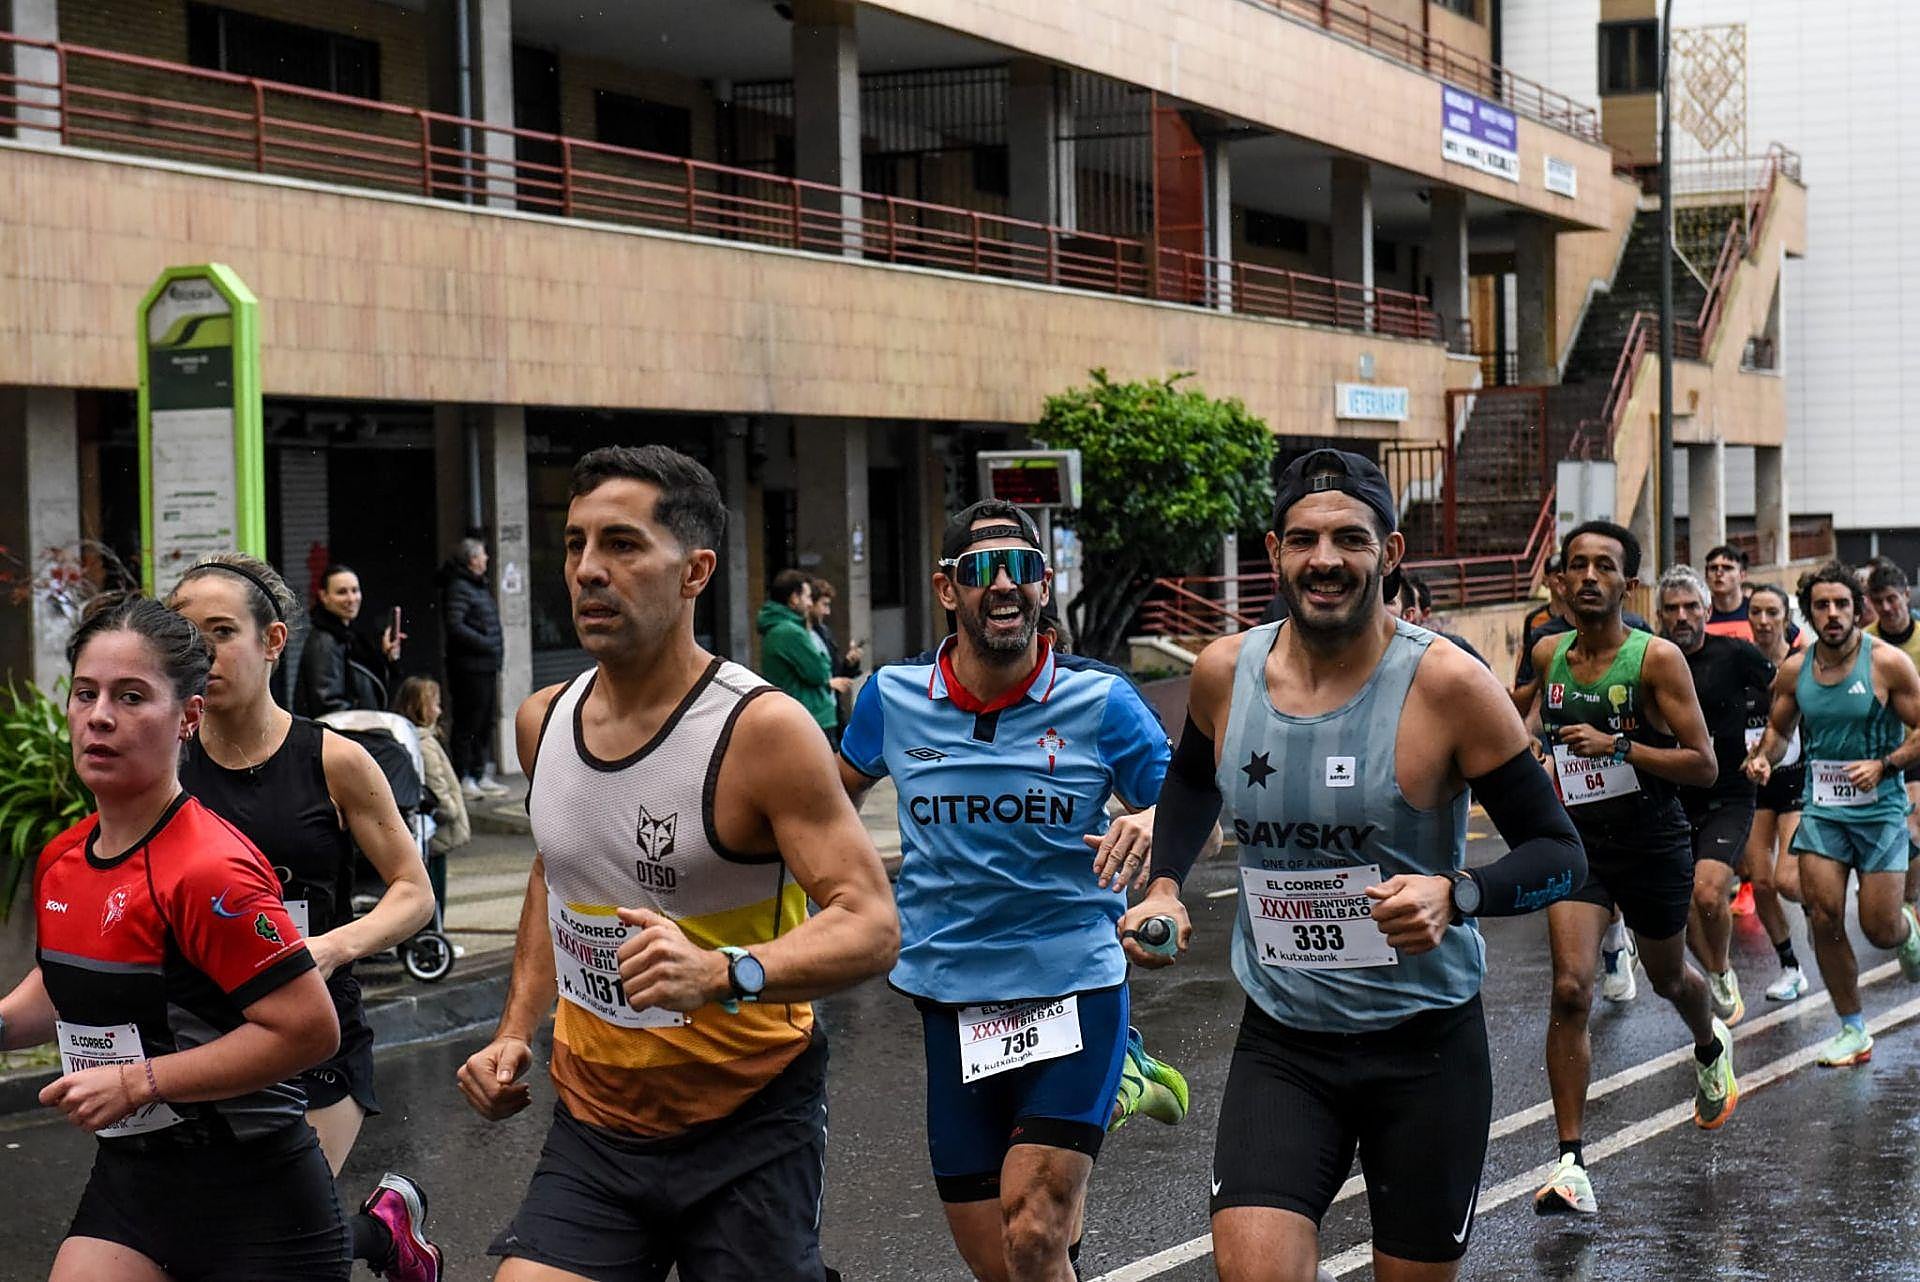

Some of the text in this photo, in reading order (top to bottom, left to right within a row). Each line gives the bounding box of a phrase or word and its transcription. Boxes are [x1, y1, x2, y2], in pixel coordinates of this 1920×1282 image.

[1585, 772, 1605, 790] 64
[910, 788, 1074, 825] CITROËN
[1233, 818, 1376, 850] SAYSKY
[637, 861, 676, 887] OTSO
[1288, 859, 1304, 871] OF
[1266, 880, 1344, 890] EL CORREO
[1259, 897, 1312, 920] XXXVII
[1312, 896, 1370, 909] SANTURCE
[1313, 906, 1371, 919] BILBAO
[569, 918, 628, 938] CORREO
[1293, 924, 1344, 951] 333
[1280, 951, 1339, 961] kutxabank
[580, 968, 626, 1007] 1131
[1020, 1005, 1064, 1027] BILBAO
[972, 1014, 1019, 1041] XXXVII
[71, 1034, 113, 1049] EL CORREO
[1001, 1026, 1040, 1057] 736
[984, 1050, 1034, 1071] kutxabank
